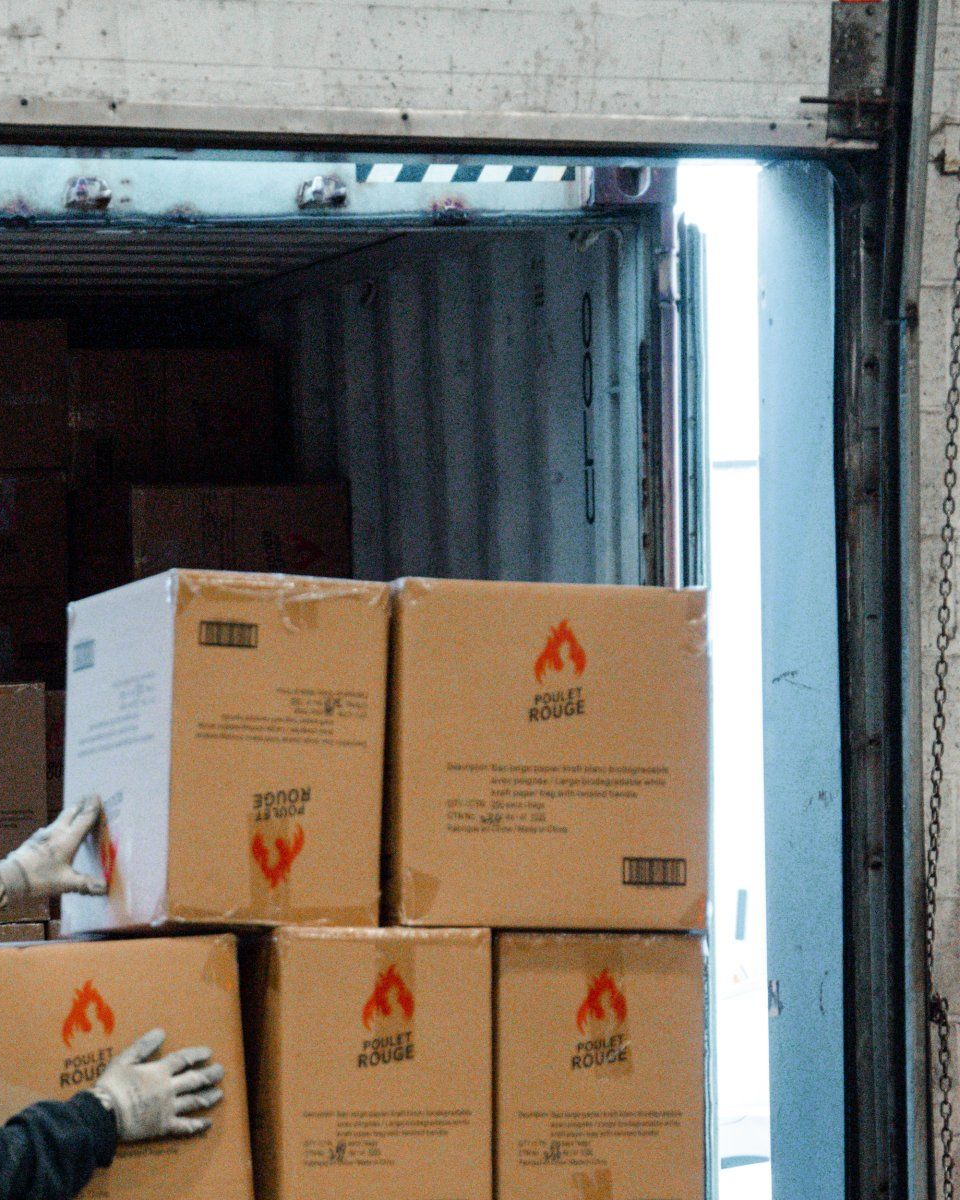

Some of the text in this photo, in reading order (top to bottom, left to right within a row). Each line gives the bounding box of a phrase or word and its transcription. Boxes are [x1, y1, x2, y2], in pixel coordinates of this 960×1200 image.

[534, 686, 582, 706] POULET
[528, 699, 585, 722] ROUGE
[253, 788, 311, 809] ROUGE
[363, 1031, 412, 1051] POULET
[577, 1034, 624, 1053] POULET
[64, 1047, 113, 1069] POULET
[358, 1043, 414, 1068] ROUGE
[571, 1047, 626, 1070] ROUGE
